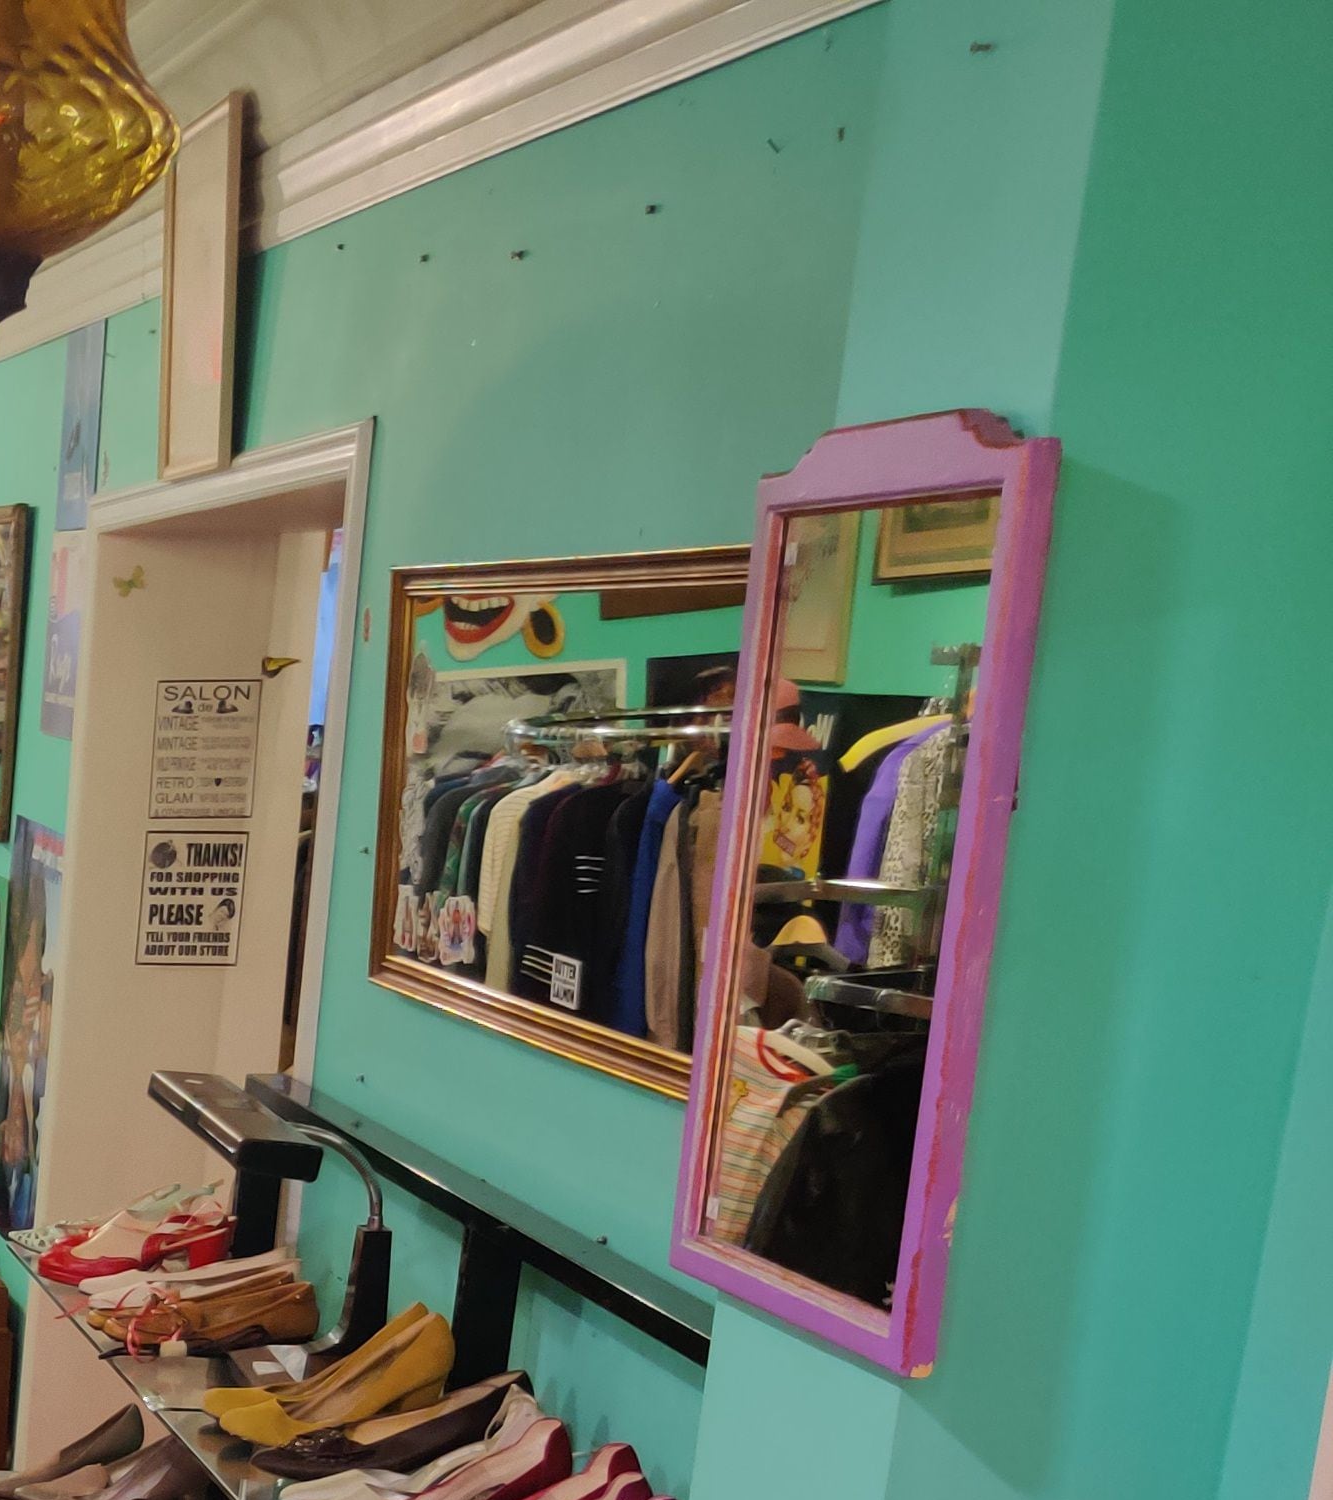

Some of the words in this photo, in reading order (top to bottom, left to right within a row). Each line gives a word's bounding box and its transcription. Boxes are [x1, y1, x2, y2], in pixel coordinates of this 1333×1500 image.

[164, 685, 251, 701] SALON
[197, 703, 214, 713] de
[157, 715, 199, 731] VINTAGE
[155, 777, 195, 789] RETRO
[154, 792, 194, 804] GLAM
[186, 843, 244, 868] THANKS!
[150, 871, 173, 883] FOR
[176, 871, 240, 884] SHOPPING
[148, 886, 205, 896] WITH
[211, 887, 238, 897] US
[148, 904, 205, 926] PLEASE
[146, 931, 164, 943] TELL
[166, 931, 191, 943] YOUR
[192, 931, 231, 944] FRIENDS
[144, 944, 177, 956] ABOUT
[178, 945, 198, 957] OUR
[199, 945, 230, 957] STORE
